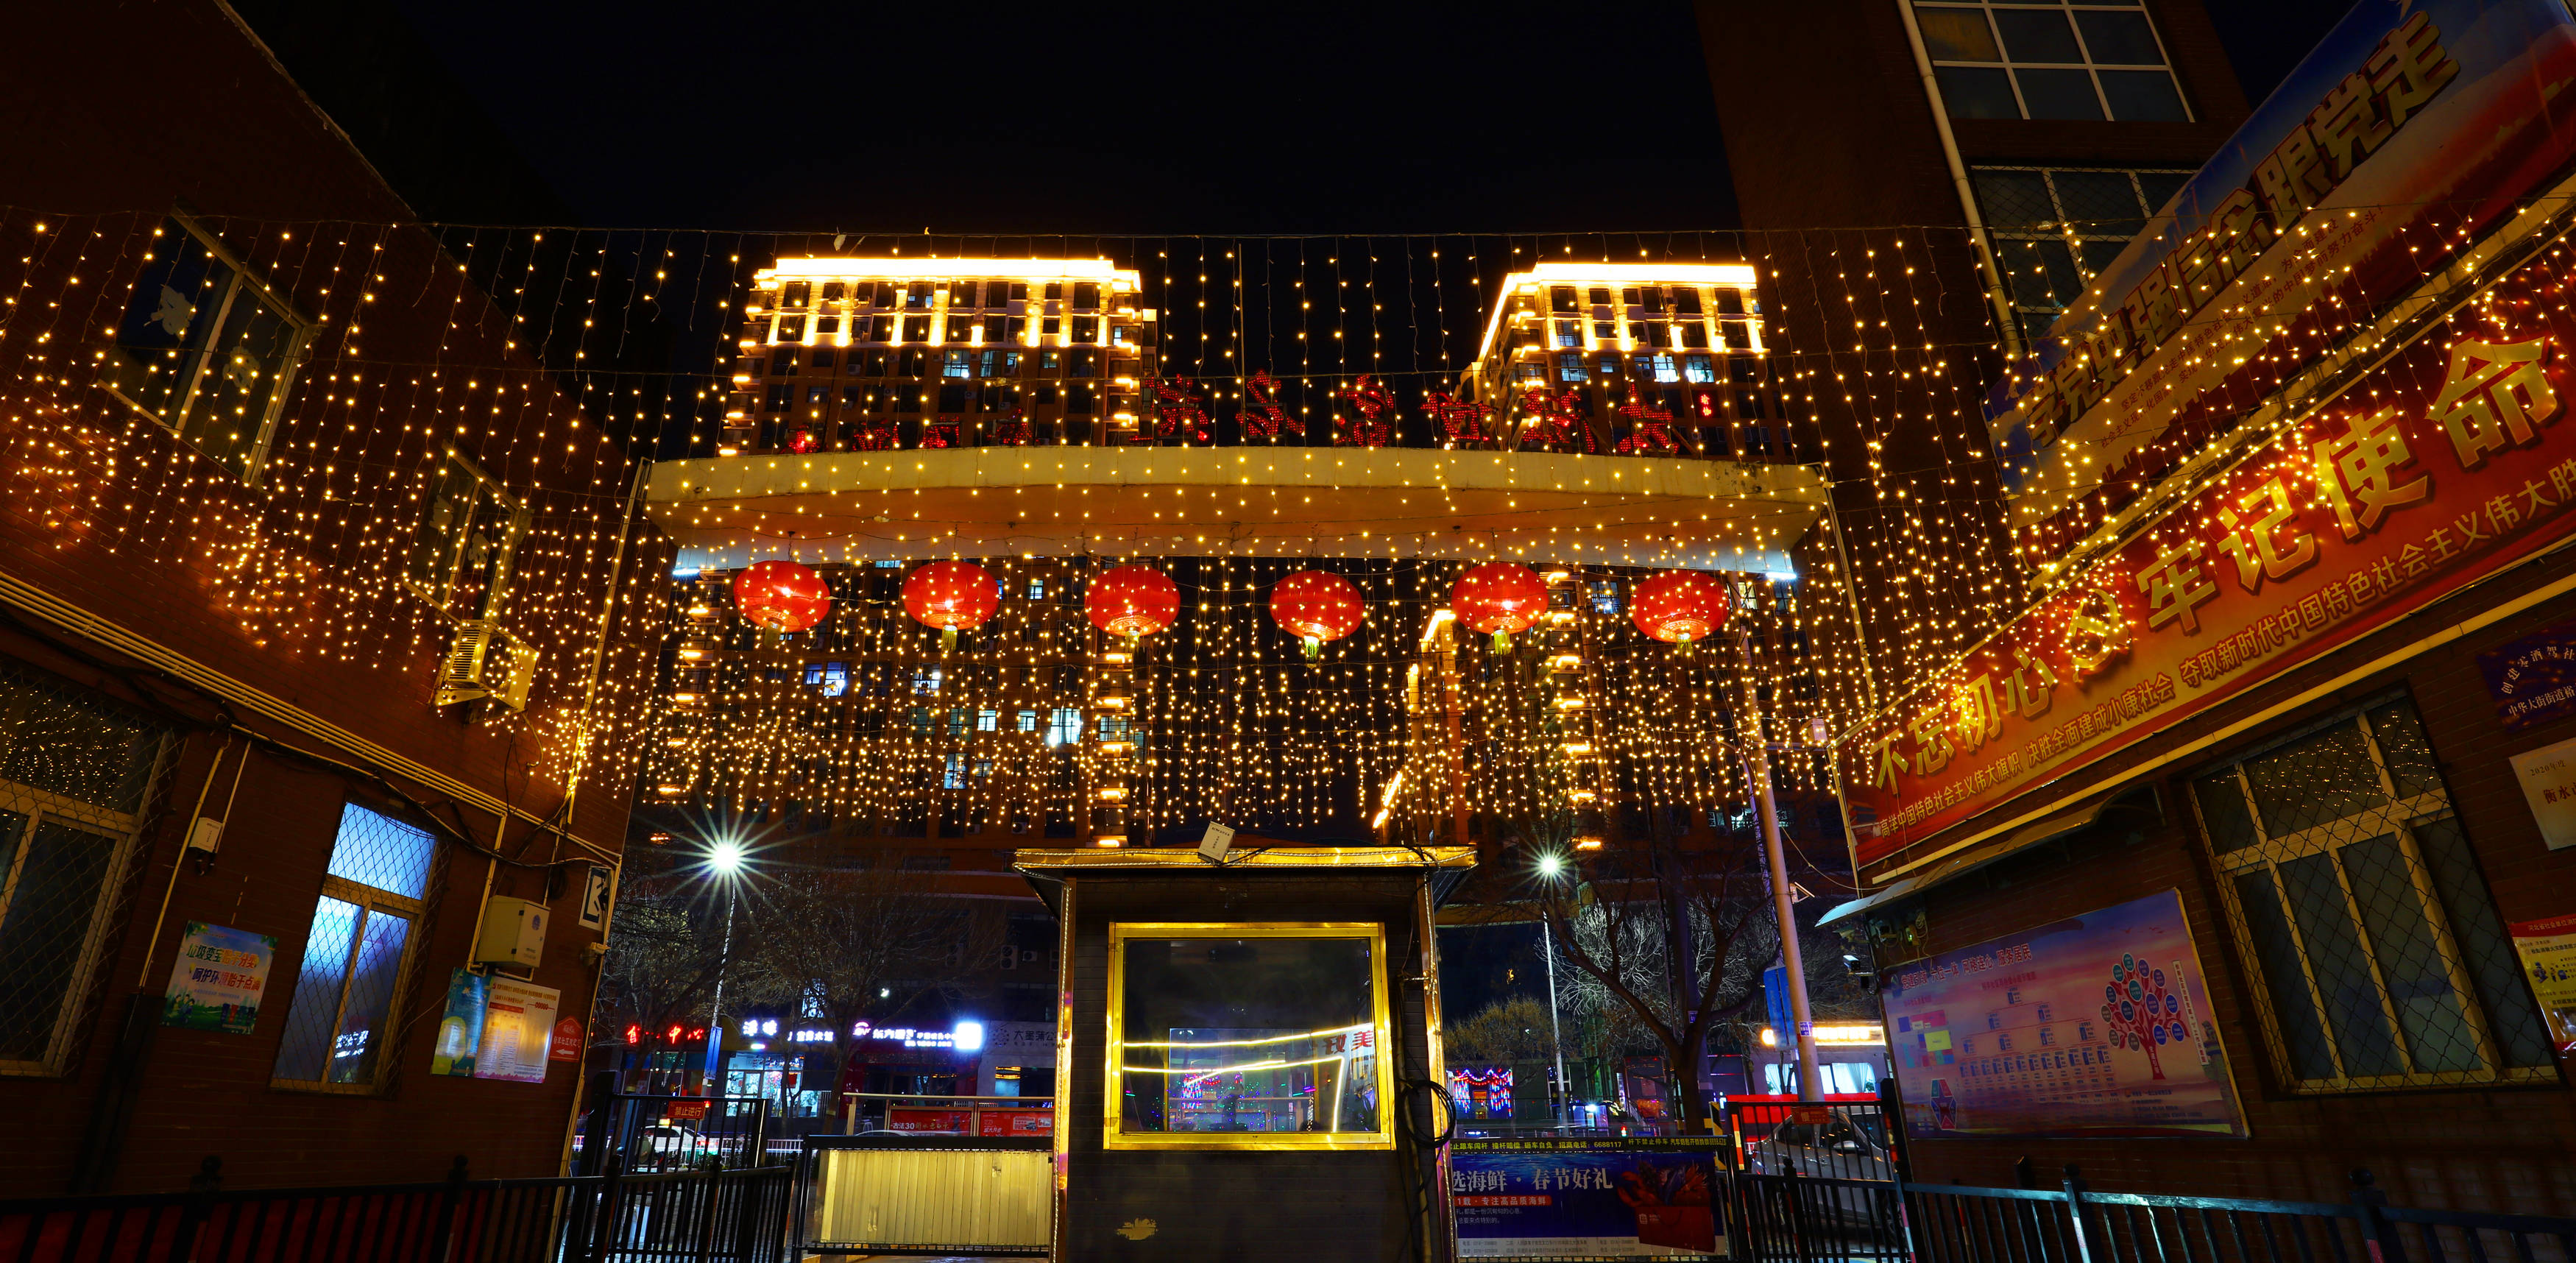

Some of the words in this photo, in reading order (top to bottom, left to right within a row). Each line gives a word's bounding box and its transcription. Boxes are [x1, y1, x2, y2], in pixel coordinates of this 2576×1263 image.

[2025, 10, 2461, 449] 学党史强信念跟党走
[1874, 646, 2058, 795] 不忘初心
[2136, 336, 2558, 634] 牢记使命
[1880, 751, 2024, 840] 高举中国特色社会主义伟大旗帜
[2025, 673, 2173, 766] 决胜全面建成小康社会
[2181, 458, 2576, 686] 夺取新时代中国特色社会主义伟大胜
[1901, 970, 1928, 990] 党建引领
[1931, 961, 1959, 982] 六位一体
[1961, 953, 1994, 976] 网格连心
[1996, 943, 2032, 966] 服务居民
[674, 1106, 702, 1117] 禁止逆行
[1451, 1142, 1488, 1150] 止跟车闯杆
